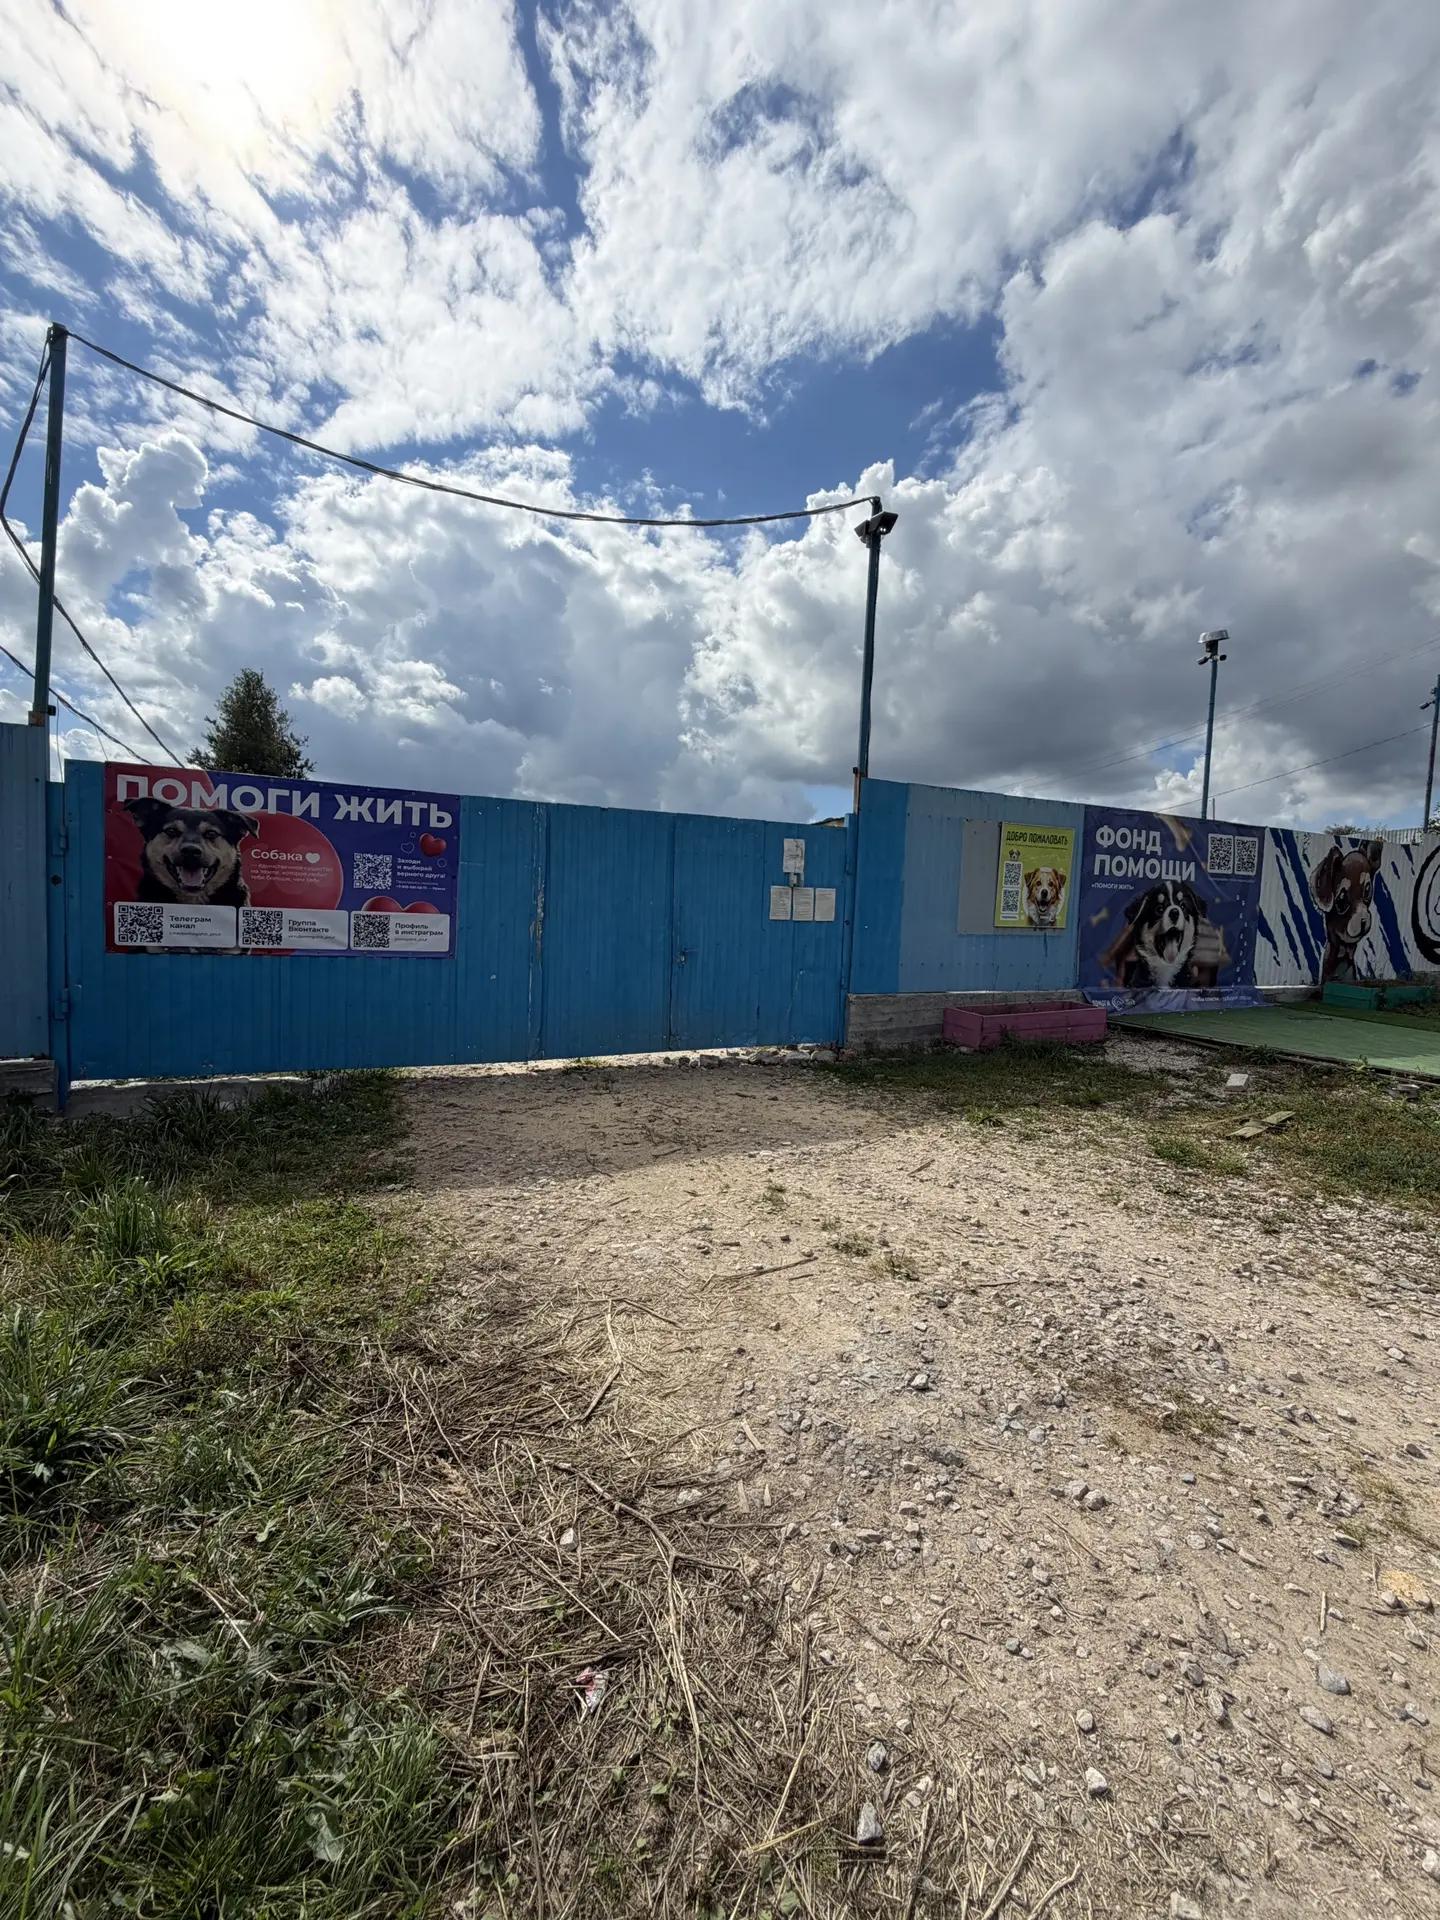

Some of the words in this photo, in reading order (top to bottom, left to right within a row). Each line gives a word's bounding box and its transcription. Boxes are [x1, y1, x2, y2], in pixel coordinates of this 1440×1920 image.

[117, 775, 320, 819] ПОМОГИ
[334, 795, 453, 829] ЖИТЬ
[1095, 825, 1162, 855] ФОНД
[251, 849, 303, 861] Собака
[1094, 854, 1195, 883] ПОМОЩИ
[169, 915, 212, 923] Телеграм
[288, 919, 317, 927] Группа
